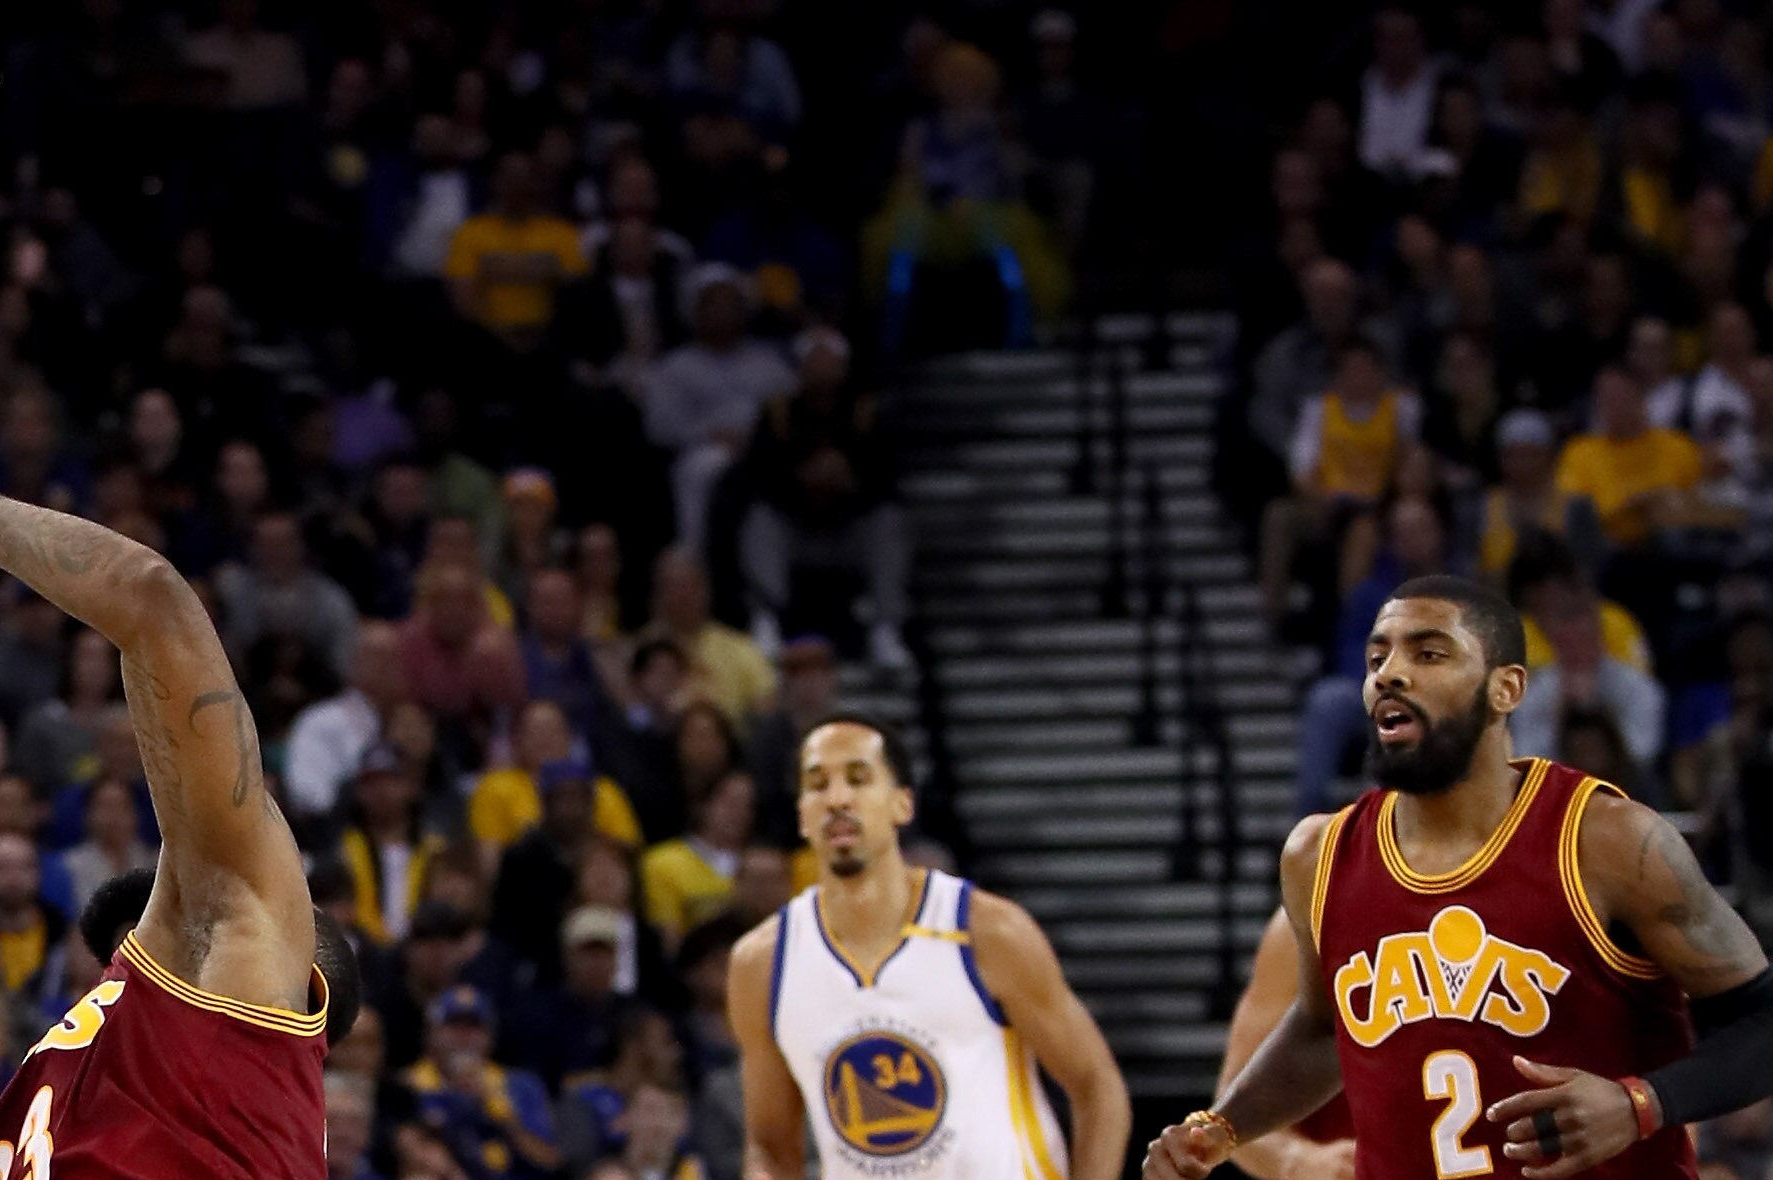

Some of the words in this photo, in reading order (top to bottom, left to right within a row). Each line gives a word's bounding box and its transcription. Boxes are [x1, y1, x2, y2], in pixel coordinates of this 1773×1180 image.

[1333, 904, 1572, 1048] CAVS
[872, 1051, 923, 1089] 34
[1421, 1048, 1494, 1180] 2
